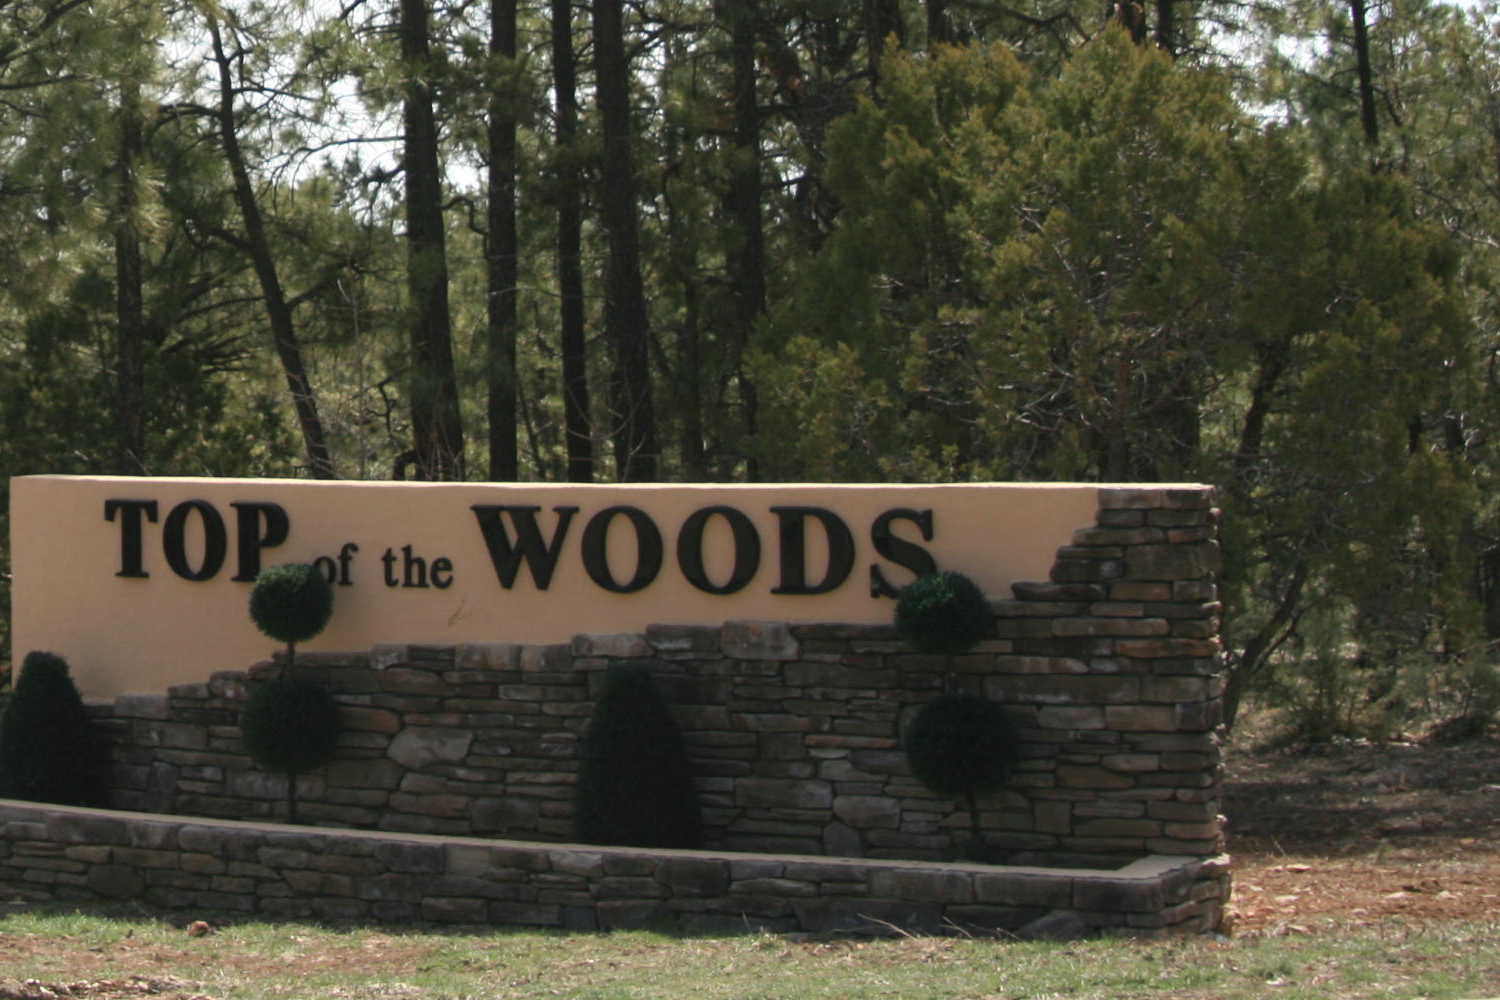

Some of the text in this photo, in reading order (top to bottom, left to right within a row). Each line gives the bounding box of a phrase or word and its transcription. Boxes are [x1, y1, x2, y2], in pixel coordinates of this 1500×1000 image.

[104, 499, 938, 600] TOP of the WOODS
